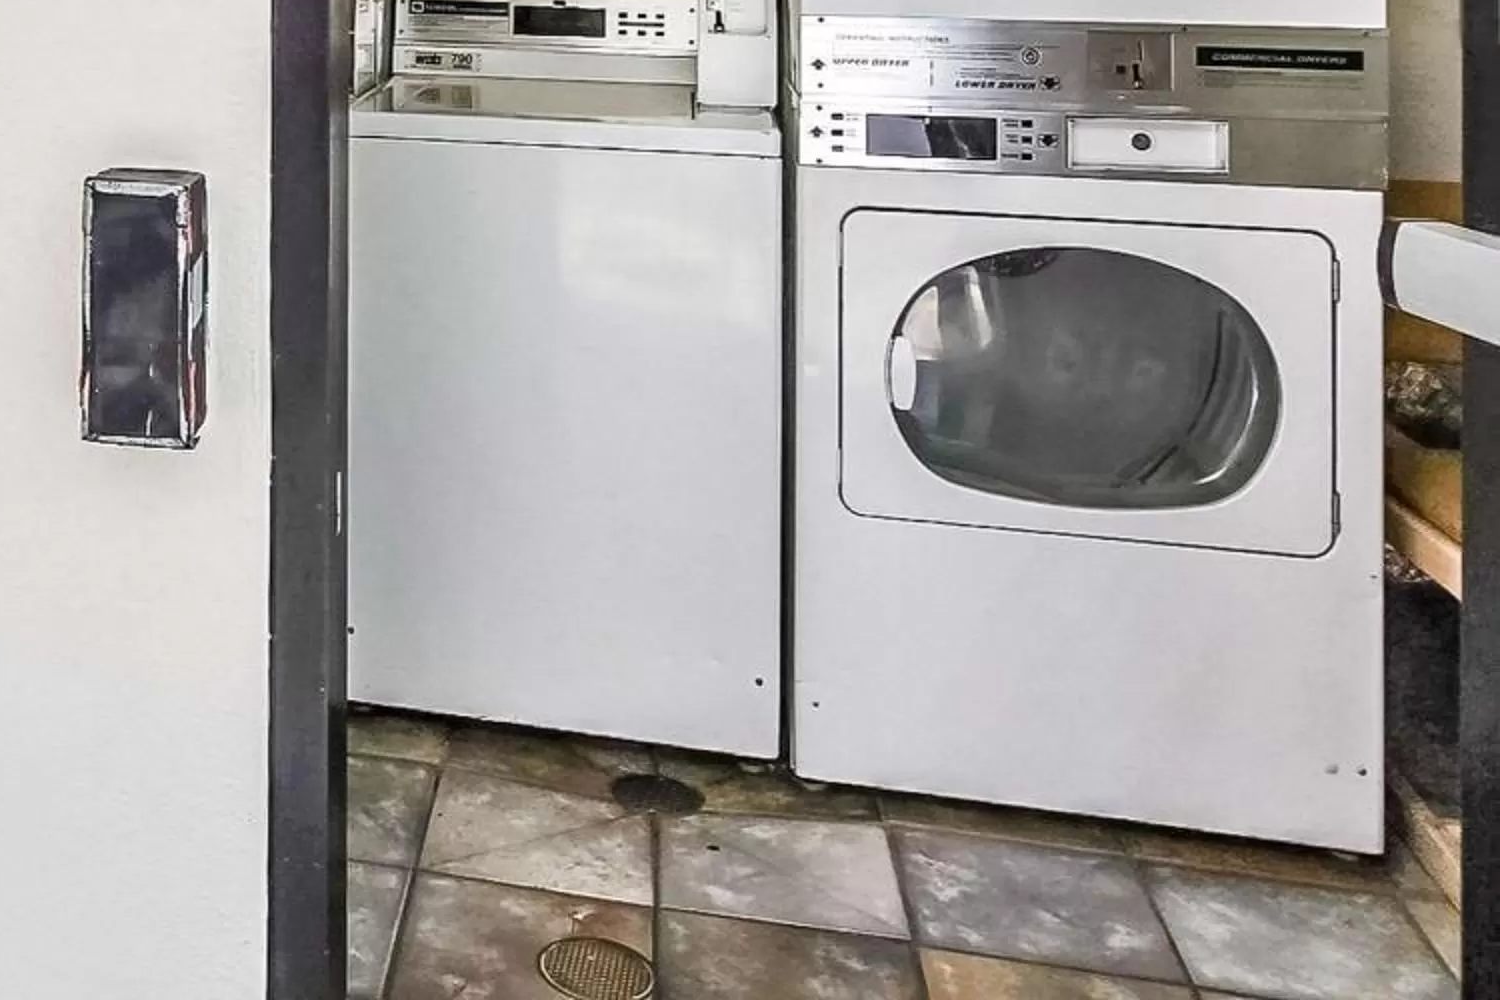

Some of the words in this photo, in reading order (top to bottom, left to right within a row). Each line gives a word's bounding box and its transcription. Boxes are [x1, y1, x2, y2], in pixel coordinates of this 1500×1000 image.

[451, 53, 473, 64] 790
[955, 80, 996, 89] LOWER
[997, 81, 1036, 90] DRYER
